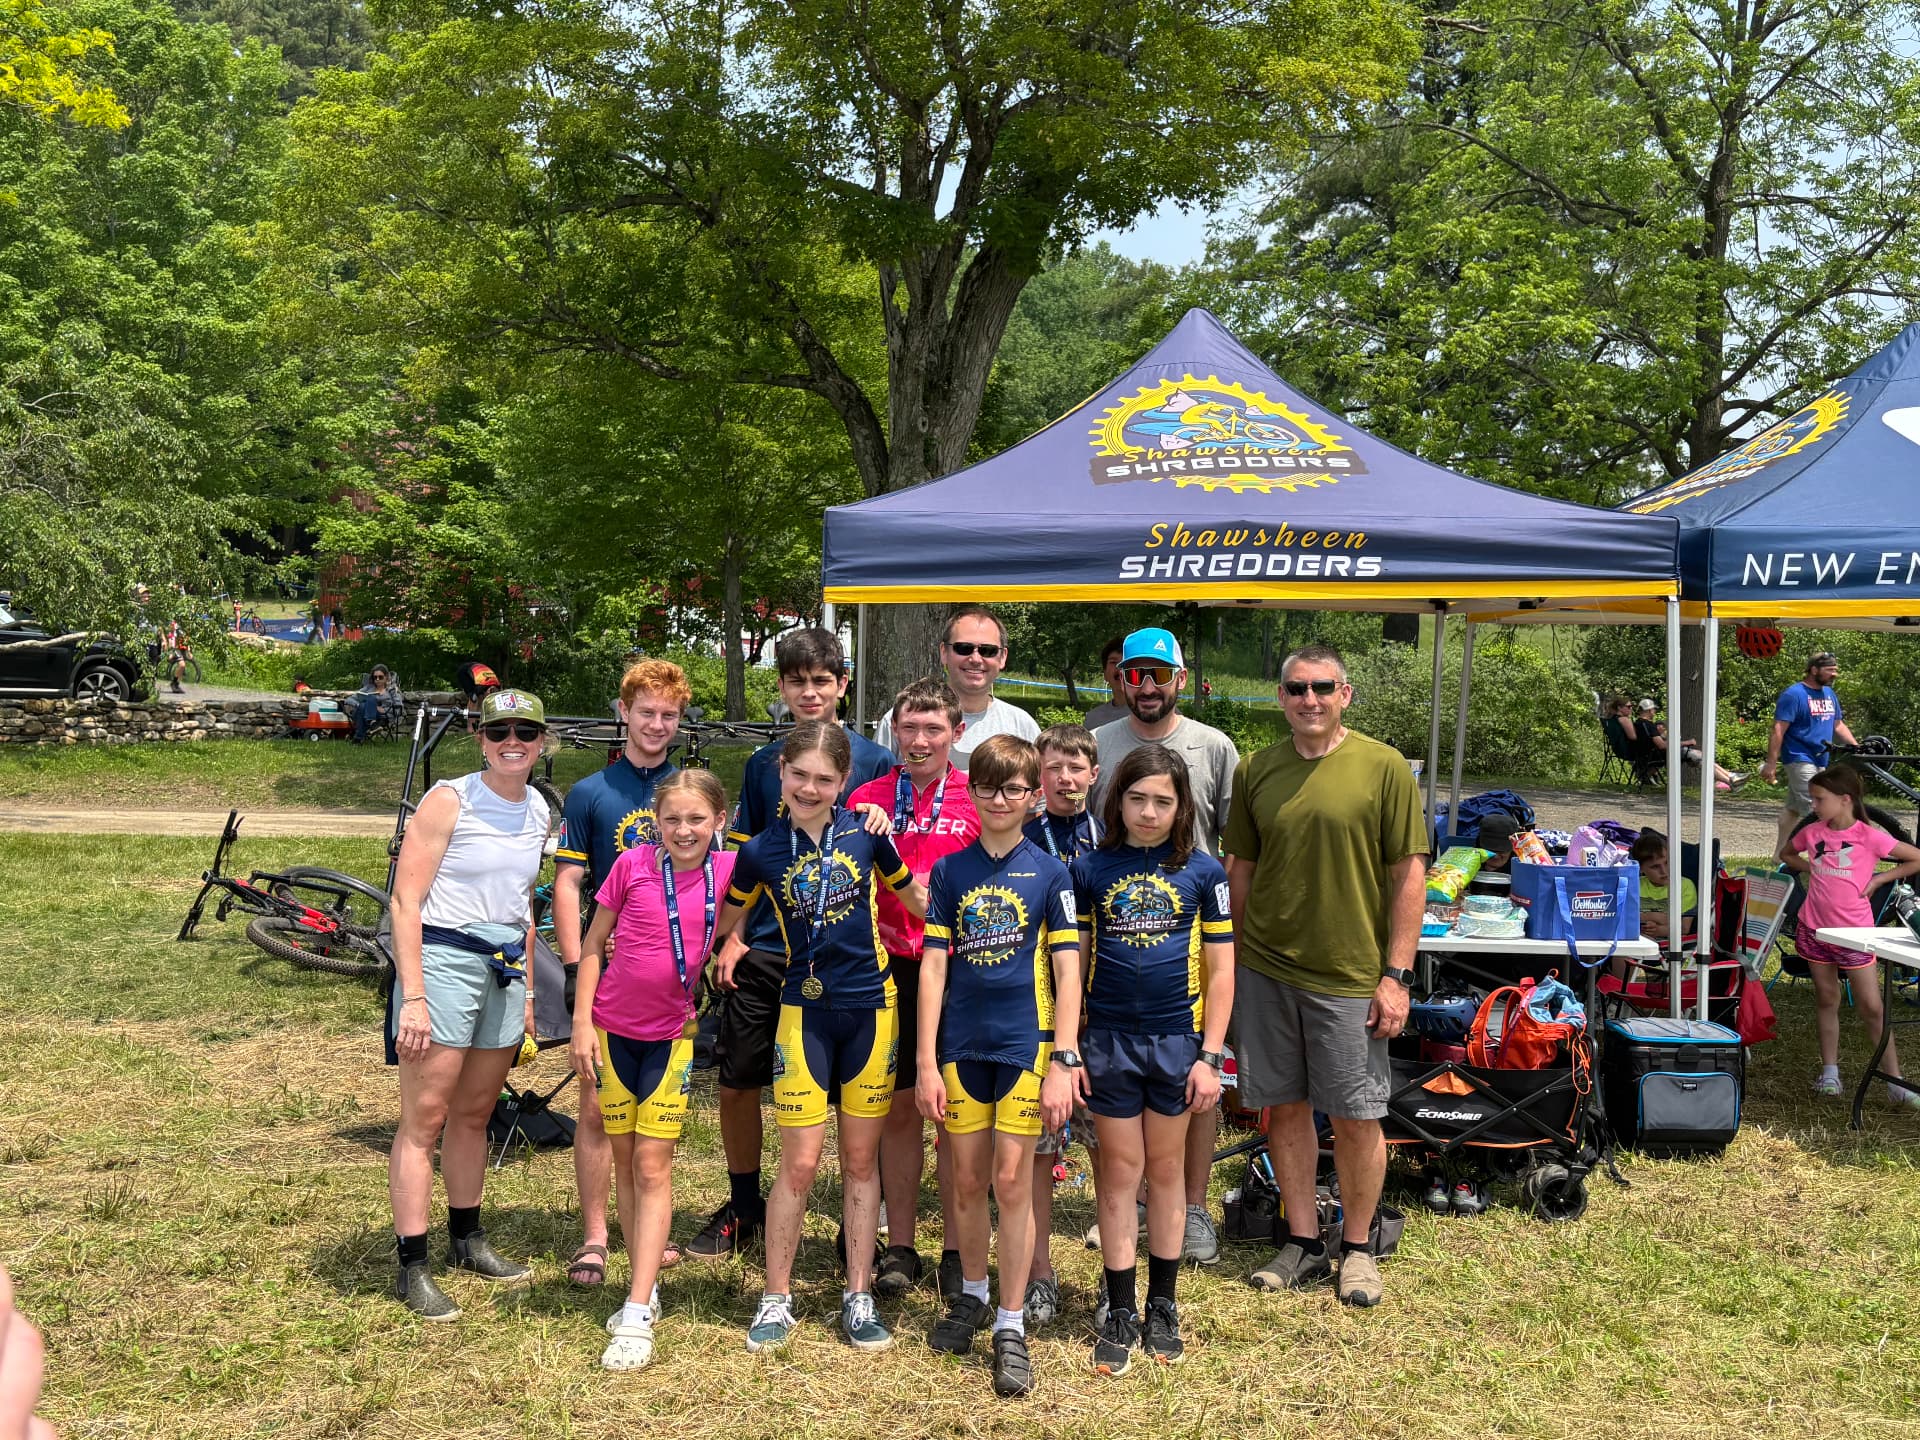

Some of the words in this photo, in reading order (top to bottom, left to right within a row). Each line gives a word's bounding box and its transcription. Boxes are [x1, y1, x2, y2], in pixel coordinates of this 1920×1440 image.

[1105, 455, 1352, 478] SHREDDERS
[1122, 443, 1328, 464] Shawsheen
[1144, 520, 1369, 551] Shawsheen
[1118, 553, 1383, 580] SHREDDERS
[1741, 552, 1856, 587] NEW
[664, 862, 674, 896] SHIMANO
[816, 879, 829, 915] SHIMANO
[672, 924, 683, 960] SHIMANO
